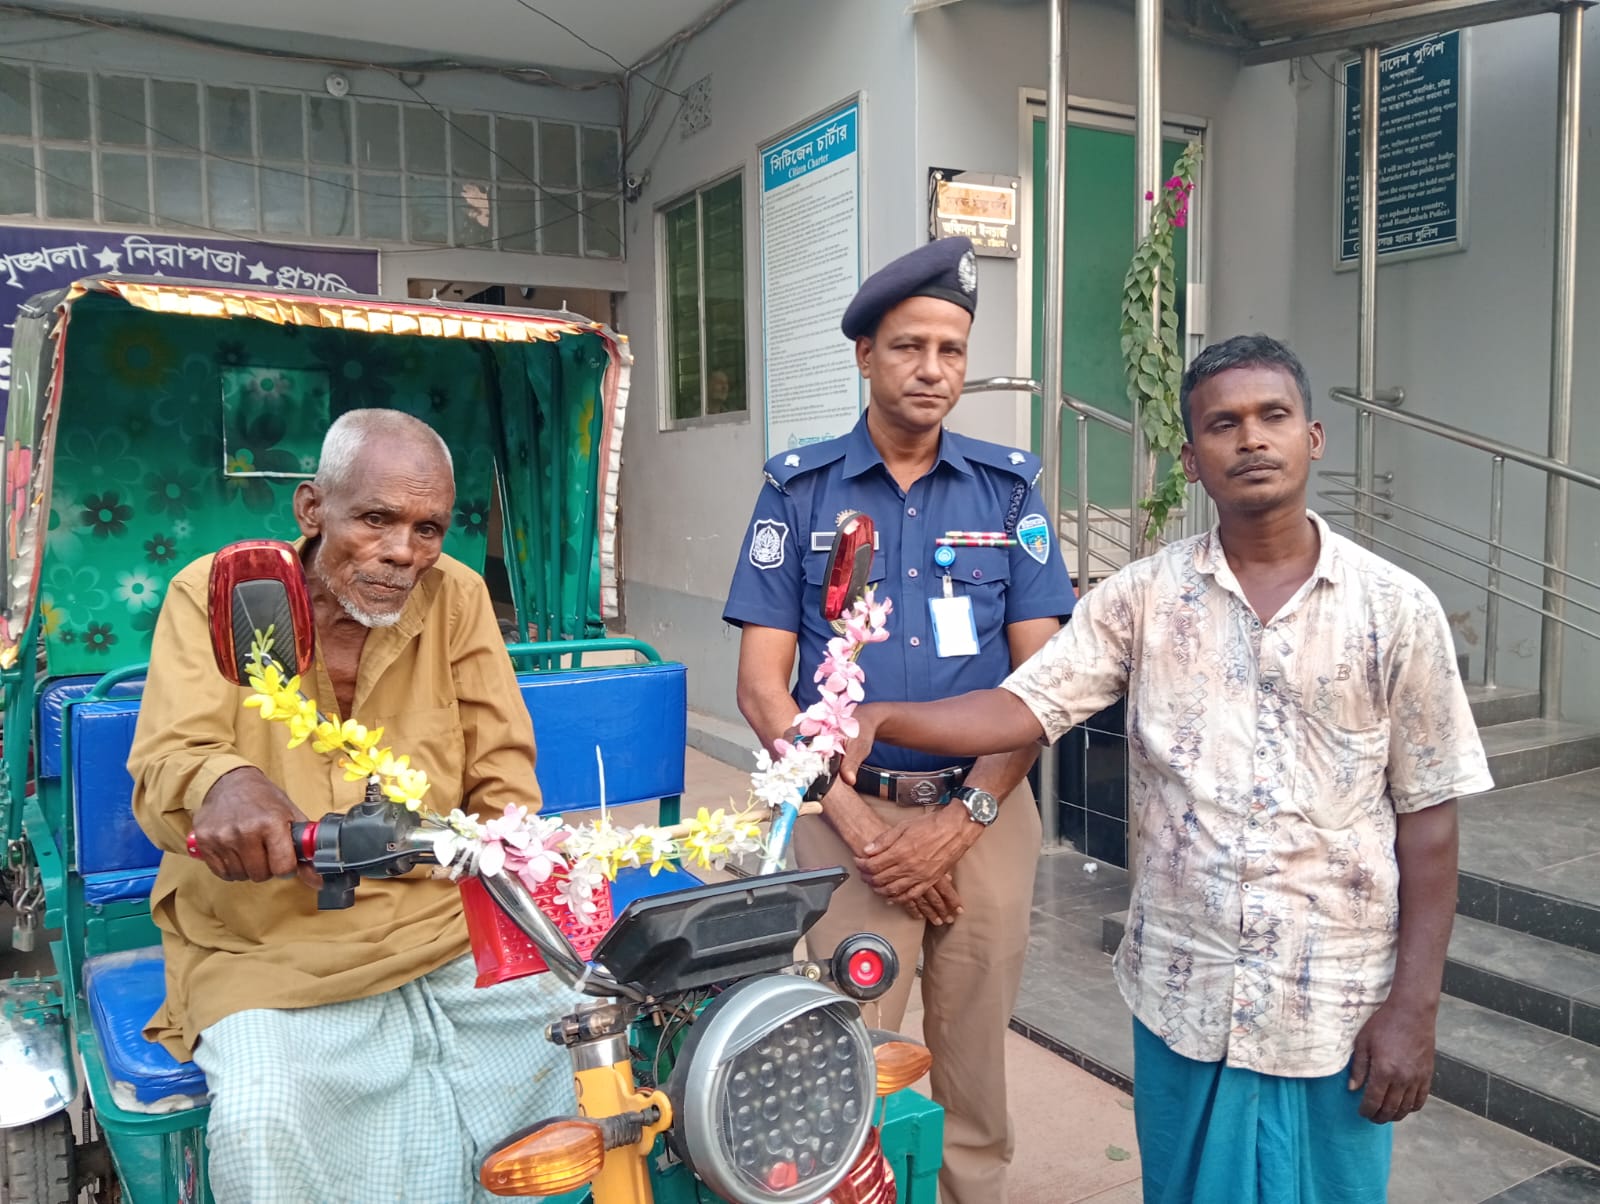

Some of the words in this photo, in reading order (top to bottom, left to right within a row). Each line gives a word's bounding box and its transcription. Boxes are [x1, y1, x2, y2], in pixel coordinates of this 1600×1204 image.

[1413, 41, 1445, 63] পুলিশ
[770, 142, 813, 175] সিটিজেন
[816, 123, 848, 151] চার্টার
[808, 154, 829, 170] Charter
[1395, 232, 1412, 242] থানা
[1415, 226, 1438, 240] পুলিশ
[121, 235, 247, 276] নিরাপত্তা
[276, 266, 357, 293] প্রগি
